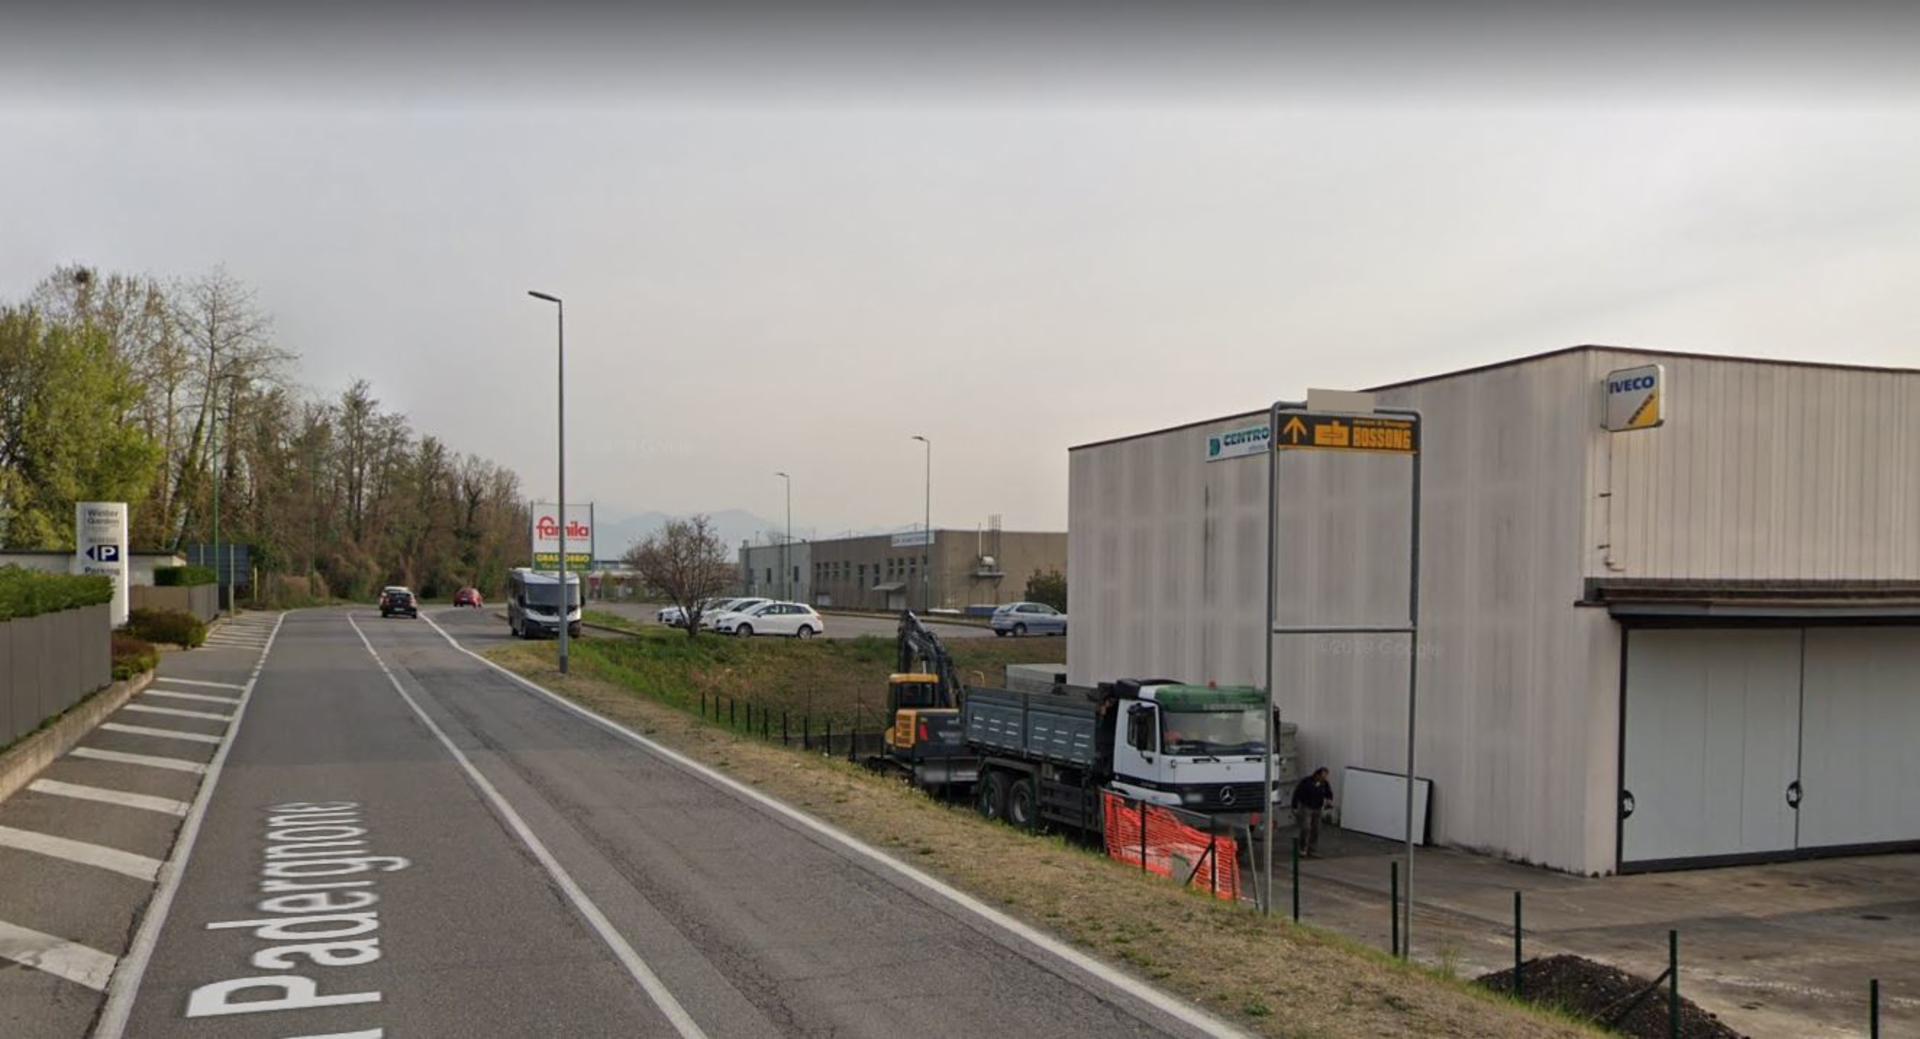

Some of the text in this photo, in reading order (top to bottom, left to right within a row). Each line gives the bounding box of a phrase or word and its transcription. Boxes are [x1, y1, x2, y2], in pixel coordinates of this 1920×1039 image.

[1609, 376, 1654, 394] IVECO
[1223, 426, 1270, 446] CENTRO
[536, 516, 589, 540] famila
[101, 547, 115, 560] P
